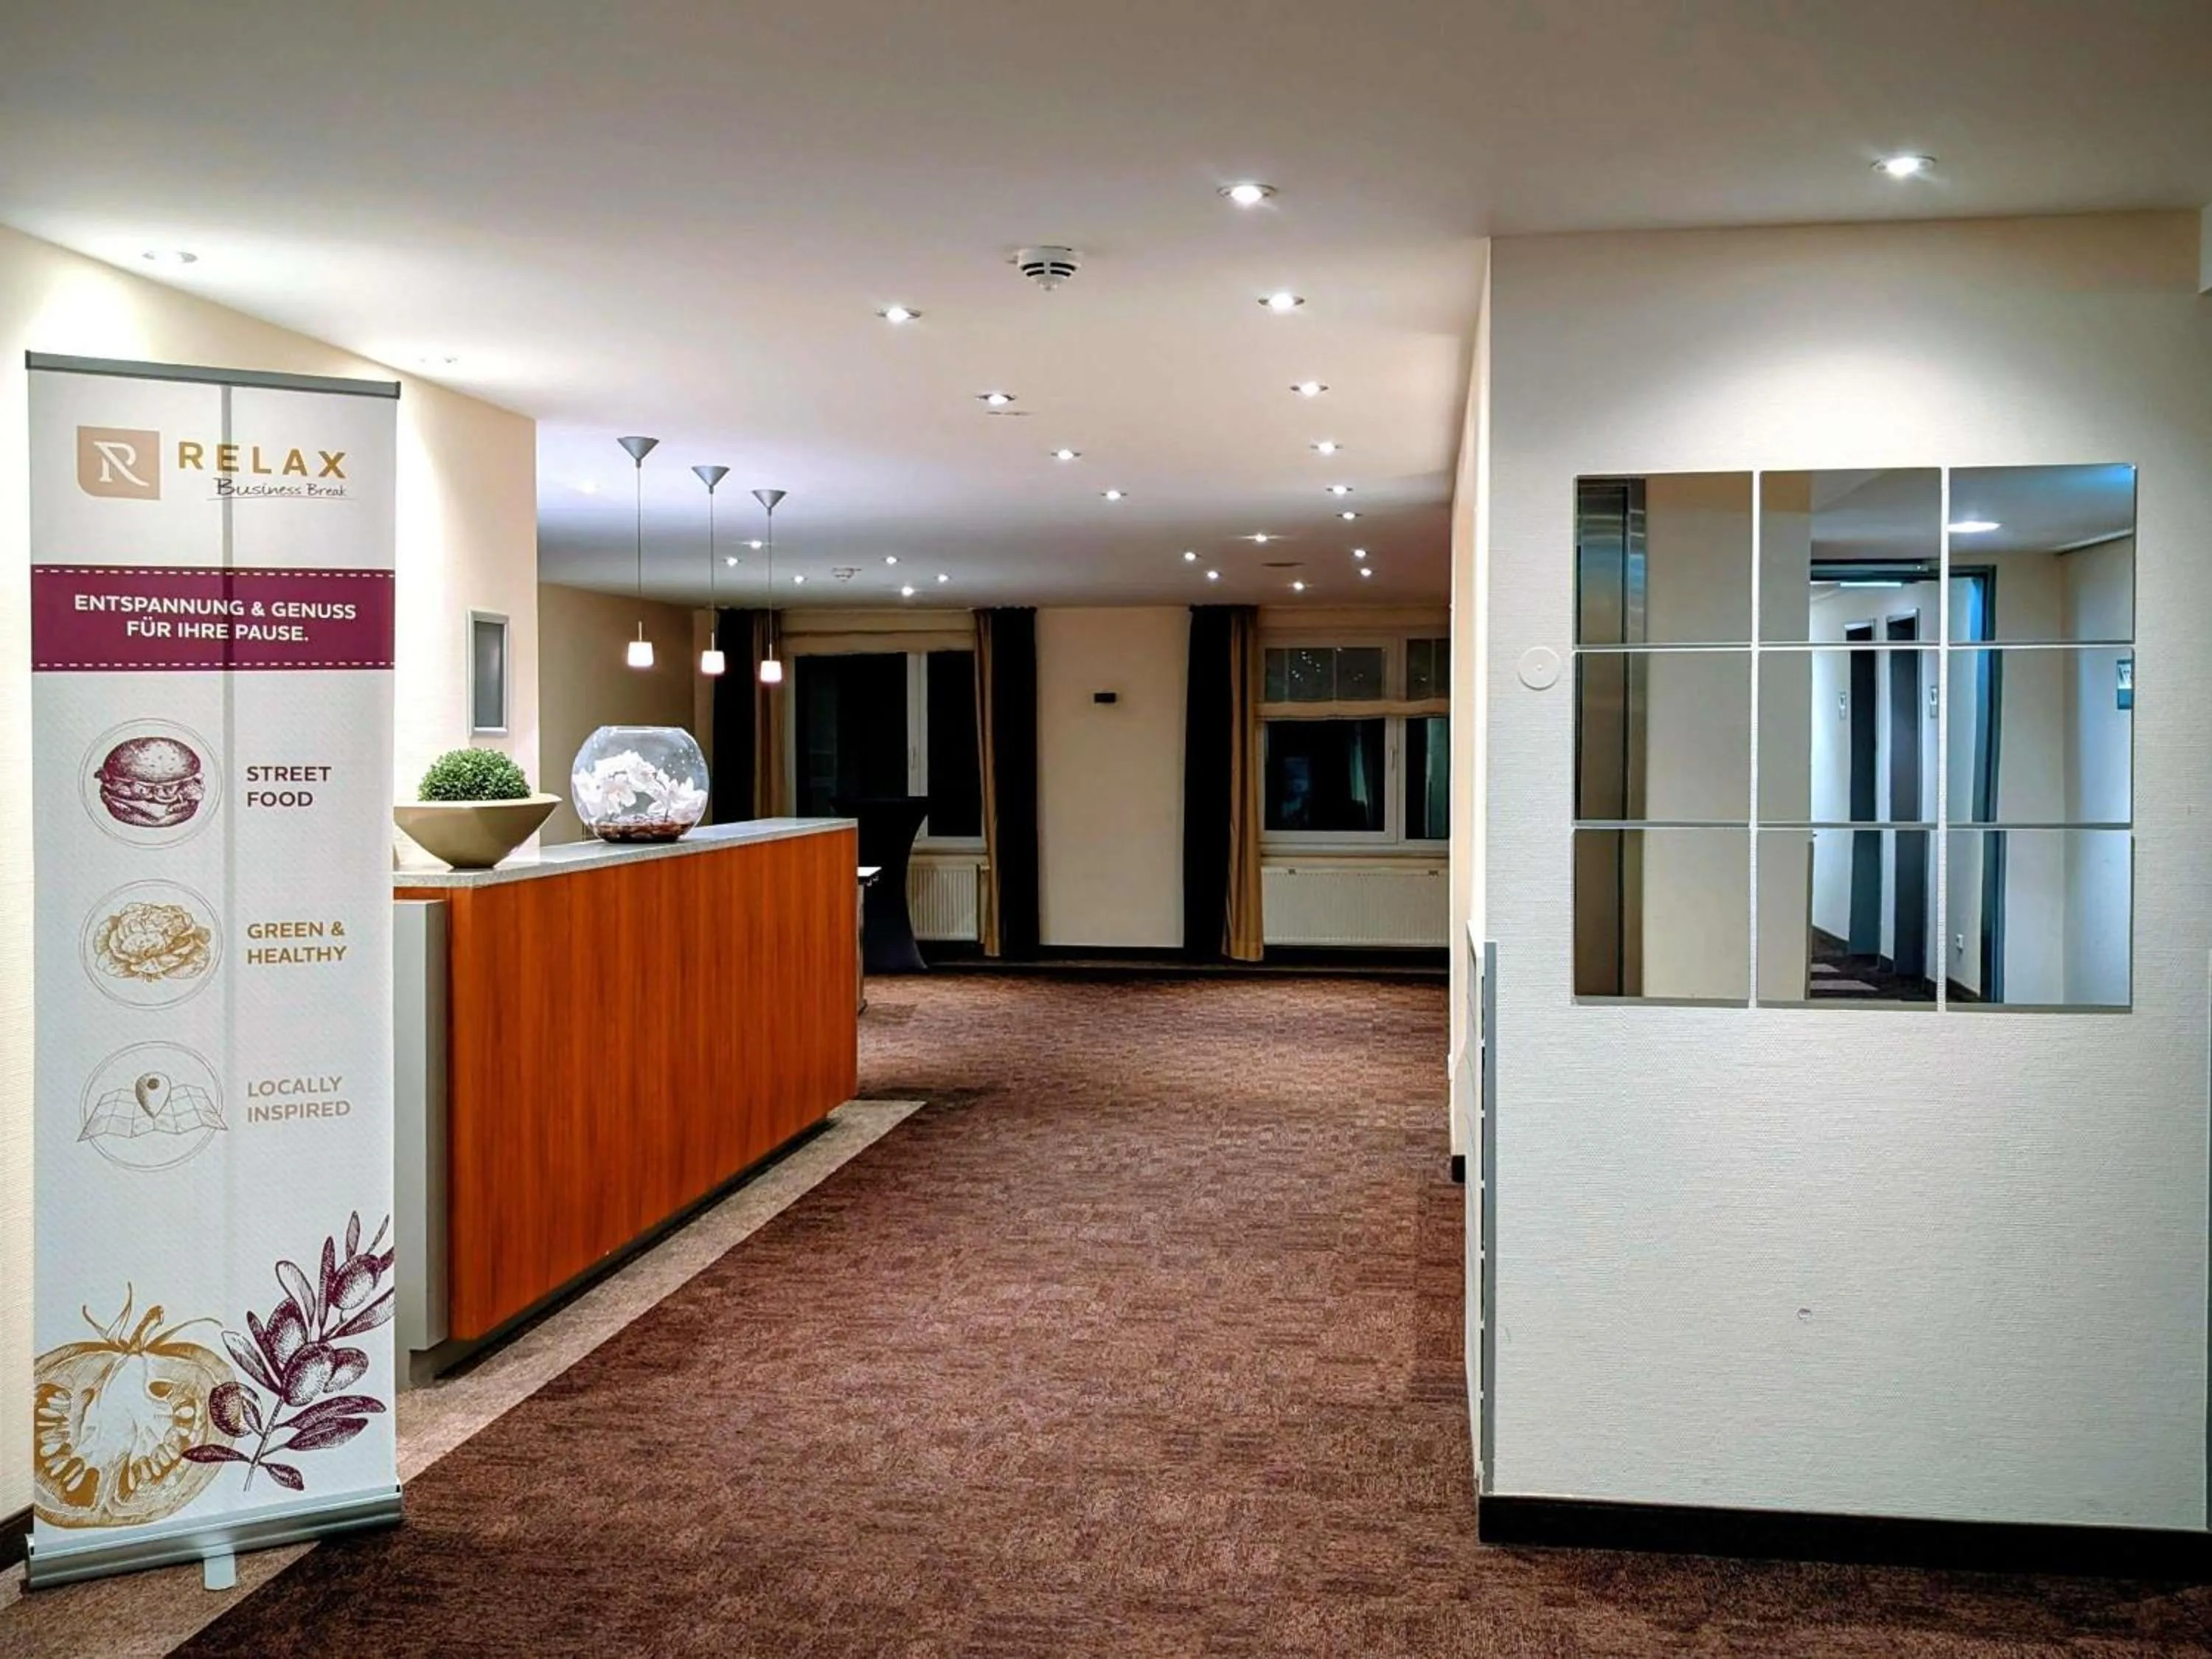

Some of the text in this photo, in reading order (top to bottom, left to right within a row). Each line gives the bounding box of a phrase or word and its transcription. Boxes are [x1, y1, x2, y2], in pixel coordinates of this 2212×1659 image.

[178, 441, 347, 479] RELAX
[213, 478, 347, 497] Business Break
[74, 594, 357, 620] ENTSPANNUNG & GENUSS
[126, 616, 310, 642] FÜR IHRE PAUSE.
[247, 766, 332, 782] STREET
[247, 791, 313, 807] FOOD
[247, 921, 345, 939] GREEN &
[248, 946, 347, 964] HEALTHY
[248, 1076, 342, 1096] LOCALLY
[248, 1100, 351, 1121] INSPIRED
